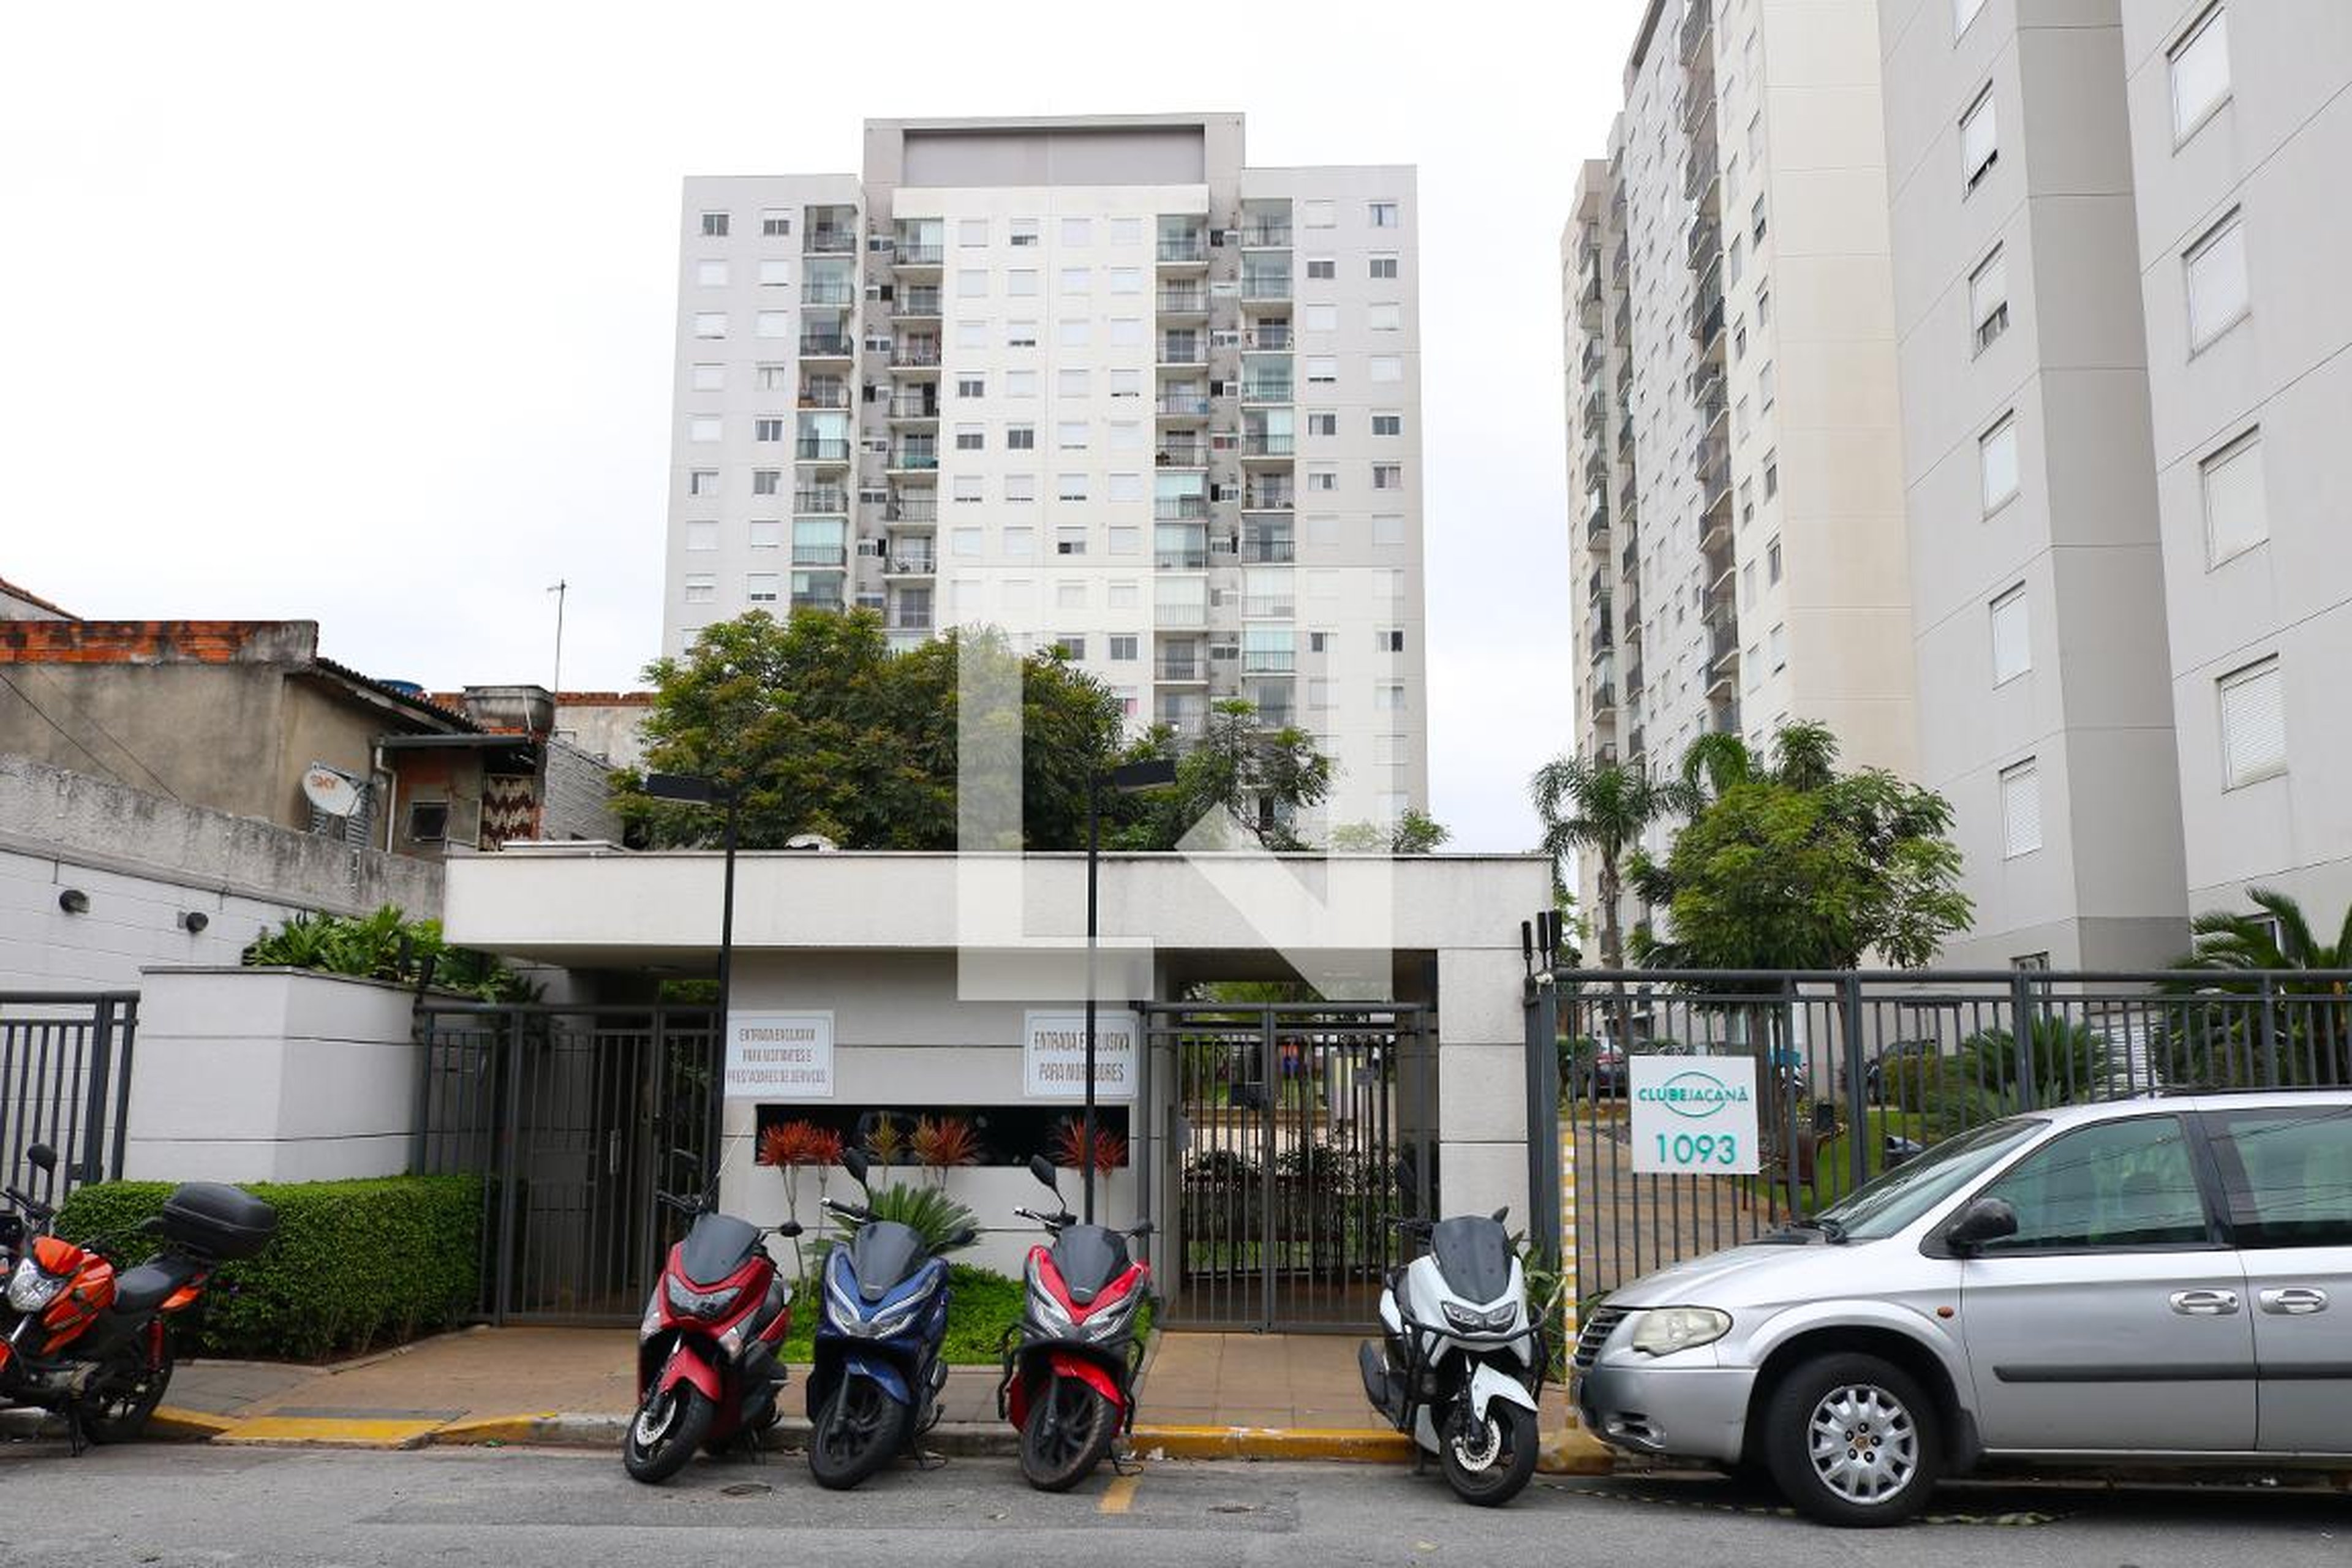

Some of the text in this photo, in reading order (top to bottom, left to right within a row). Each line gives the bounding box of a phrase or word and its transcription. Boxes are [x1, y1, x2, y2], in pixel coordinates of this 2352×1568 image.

[1034, 1031, 1077, 1051] ENTRADA
[1039, 1063, 1065, 1081] PARA
[1656, 1134, 1736, 1164] 1093
